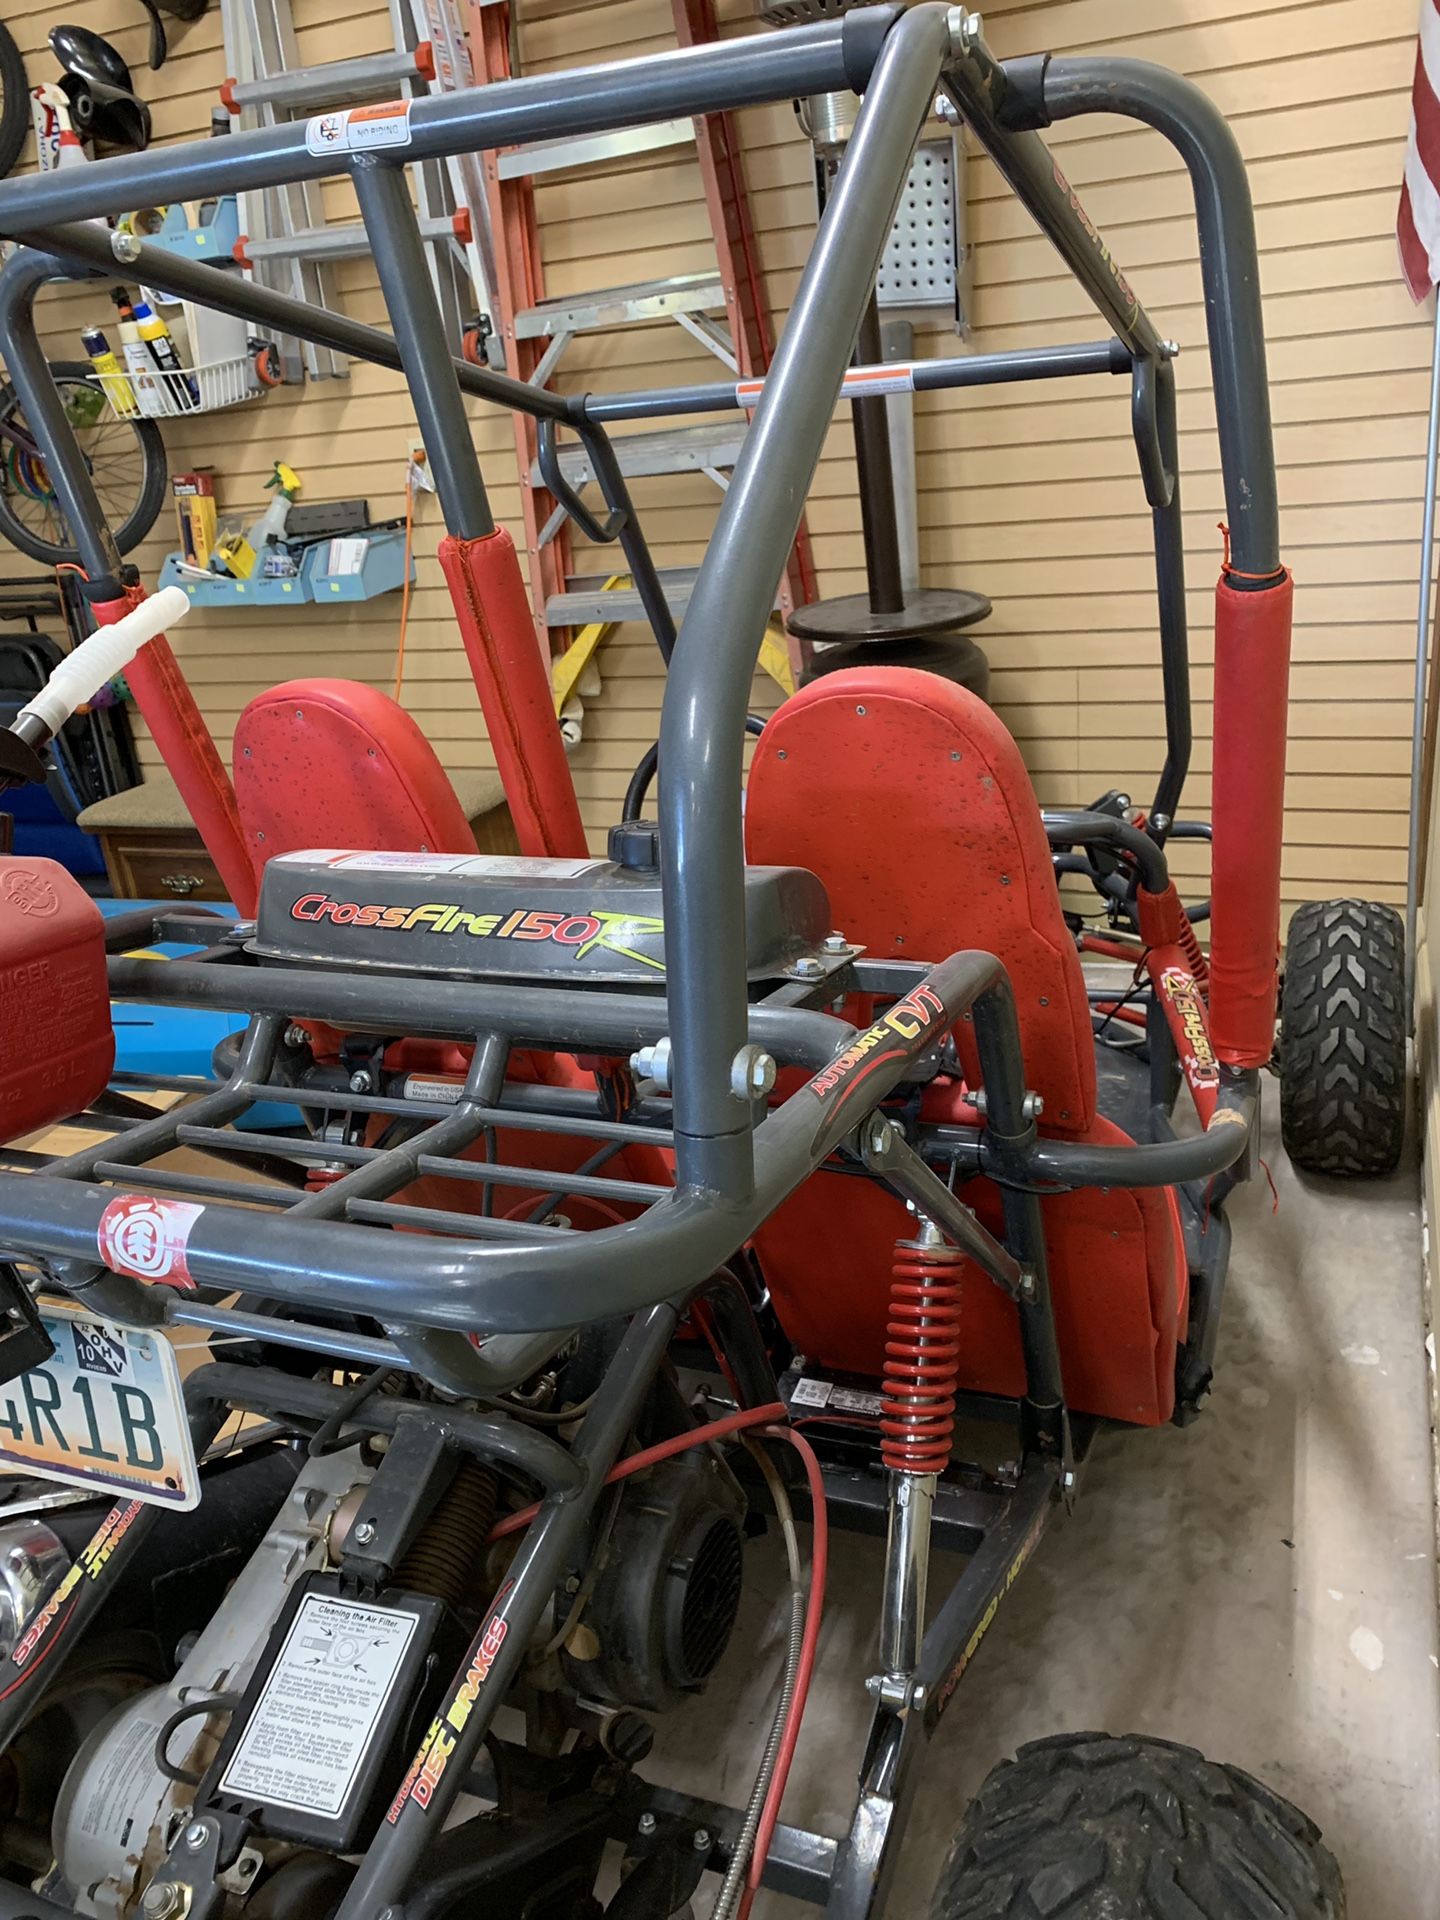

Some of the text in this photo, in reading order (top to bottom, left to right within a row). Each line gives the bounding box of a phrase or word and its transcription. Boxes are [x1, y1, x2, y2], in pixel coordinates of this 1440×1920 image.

[811, 1025, 890, 1097] AUTOMATIC
[883, 984, 944, 1040] CVT
[412, 1090, 429, 1099] Made
[77, 1343, 95, 1362] 10
[80, 1508, 122, 1566] DISC
[12, 1563, 84, 1667] BRAKES
[317, 1605, 399, 1628] Cleaning the Air Filter
[410, 1615, 509, 1810] DISC BRAKES
